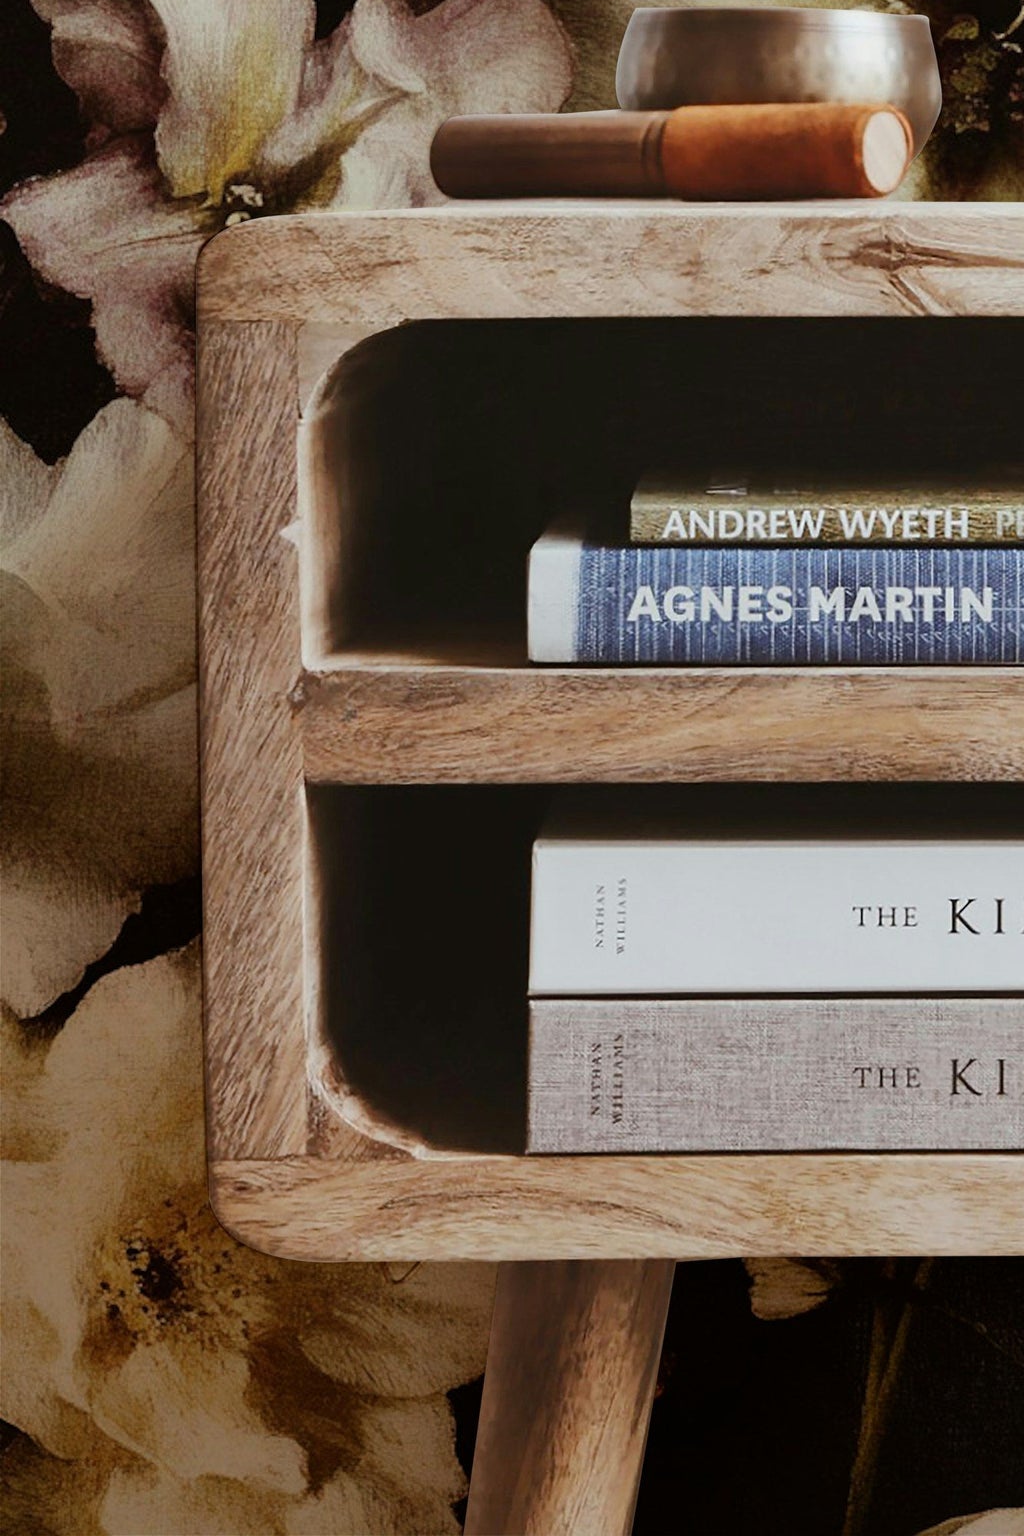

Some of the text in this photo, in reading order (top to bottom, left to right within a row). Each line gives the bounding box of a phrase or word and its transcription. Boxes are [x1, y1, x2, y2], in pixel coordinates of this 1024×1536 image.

[661, 509, 826, 540] ANDREW
[839, 509, 969, 540] WYETH
[627, 584, 993, 623] AGNES MARTIN
[595, 884, 606, 948] NATHAN
[616, 877, 628, 955] WILLIAMS
[852, 905, 919, 928] THE
[590, 1043, 602, 1117] NATHAN
[611, 1033, 624, 1125] WILLIAMS
[852, 1066, 921, 1090] THE
